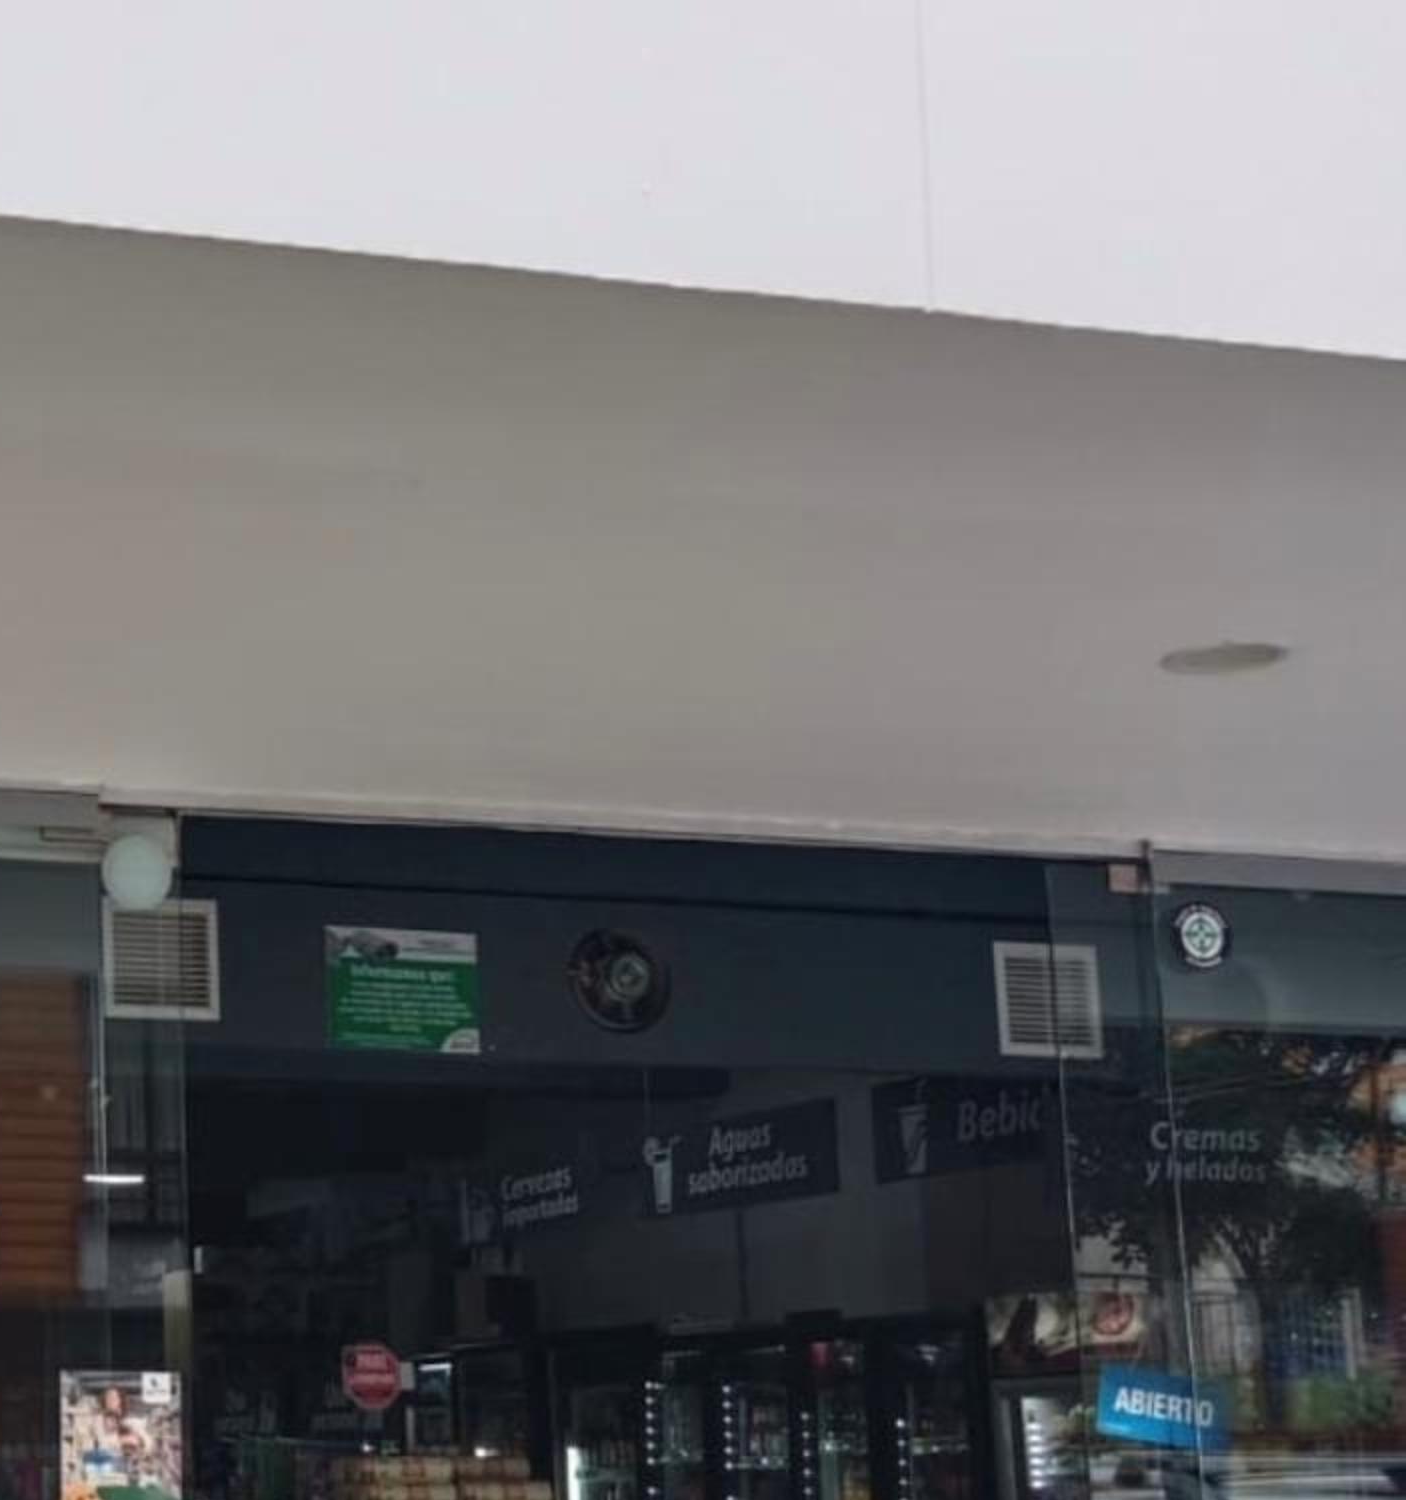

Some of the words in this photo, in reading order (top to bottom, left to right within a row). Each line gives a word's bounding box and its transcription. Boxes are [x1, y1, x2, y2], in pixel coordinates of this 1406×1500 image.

[707, 1123, 771, 1162] Aguas
[1150, 1120, 1262, 1153] Cremas
[688, 1151, 809, 1195] saborizadas
[1145, 1159, 1162, 1187] y
[1166, 1153, 1268, 1184] helados
[1113, 1386, 1214, 1427] ABIERTO
